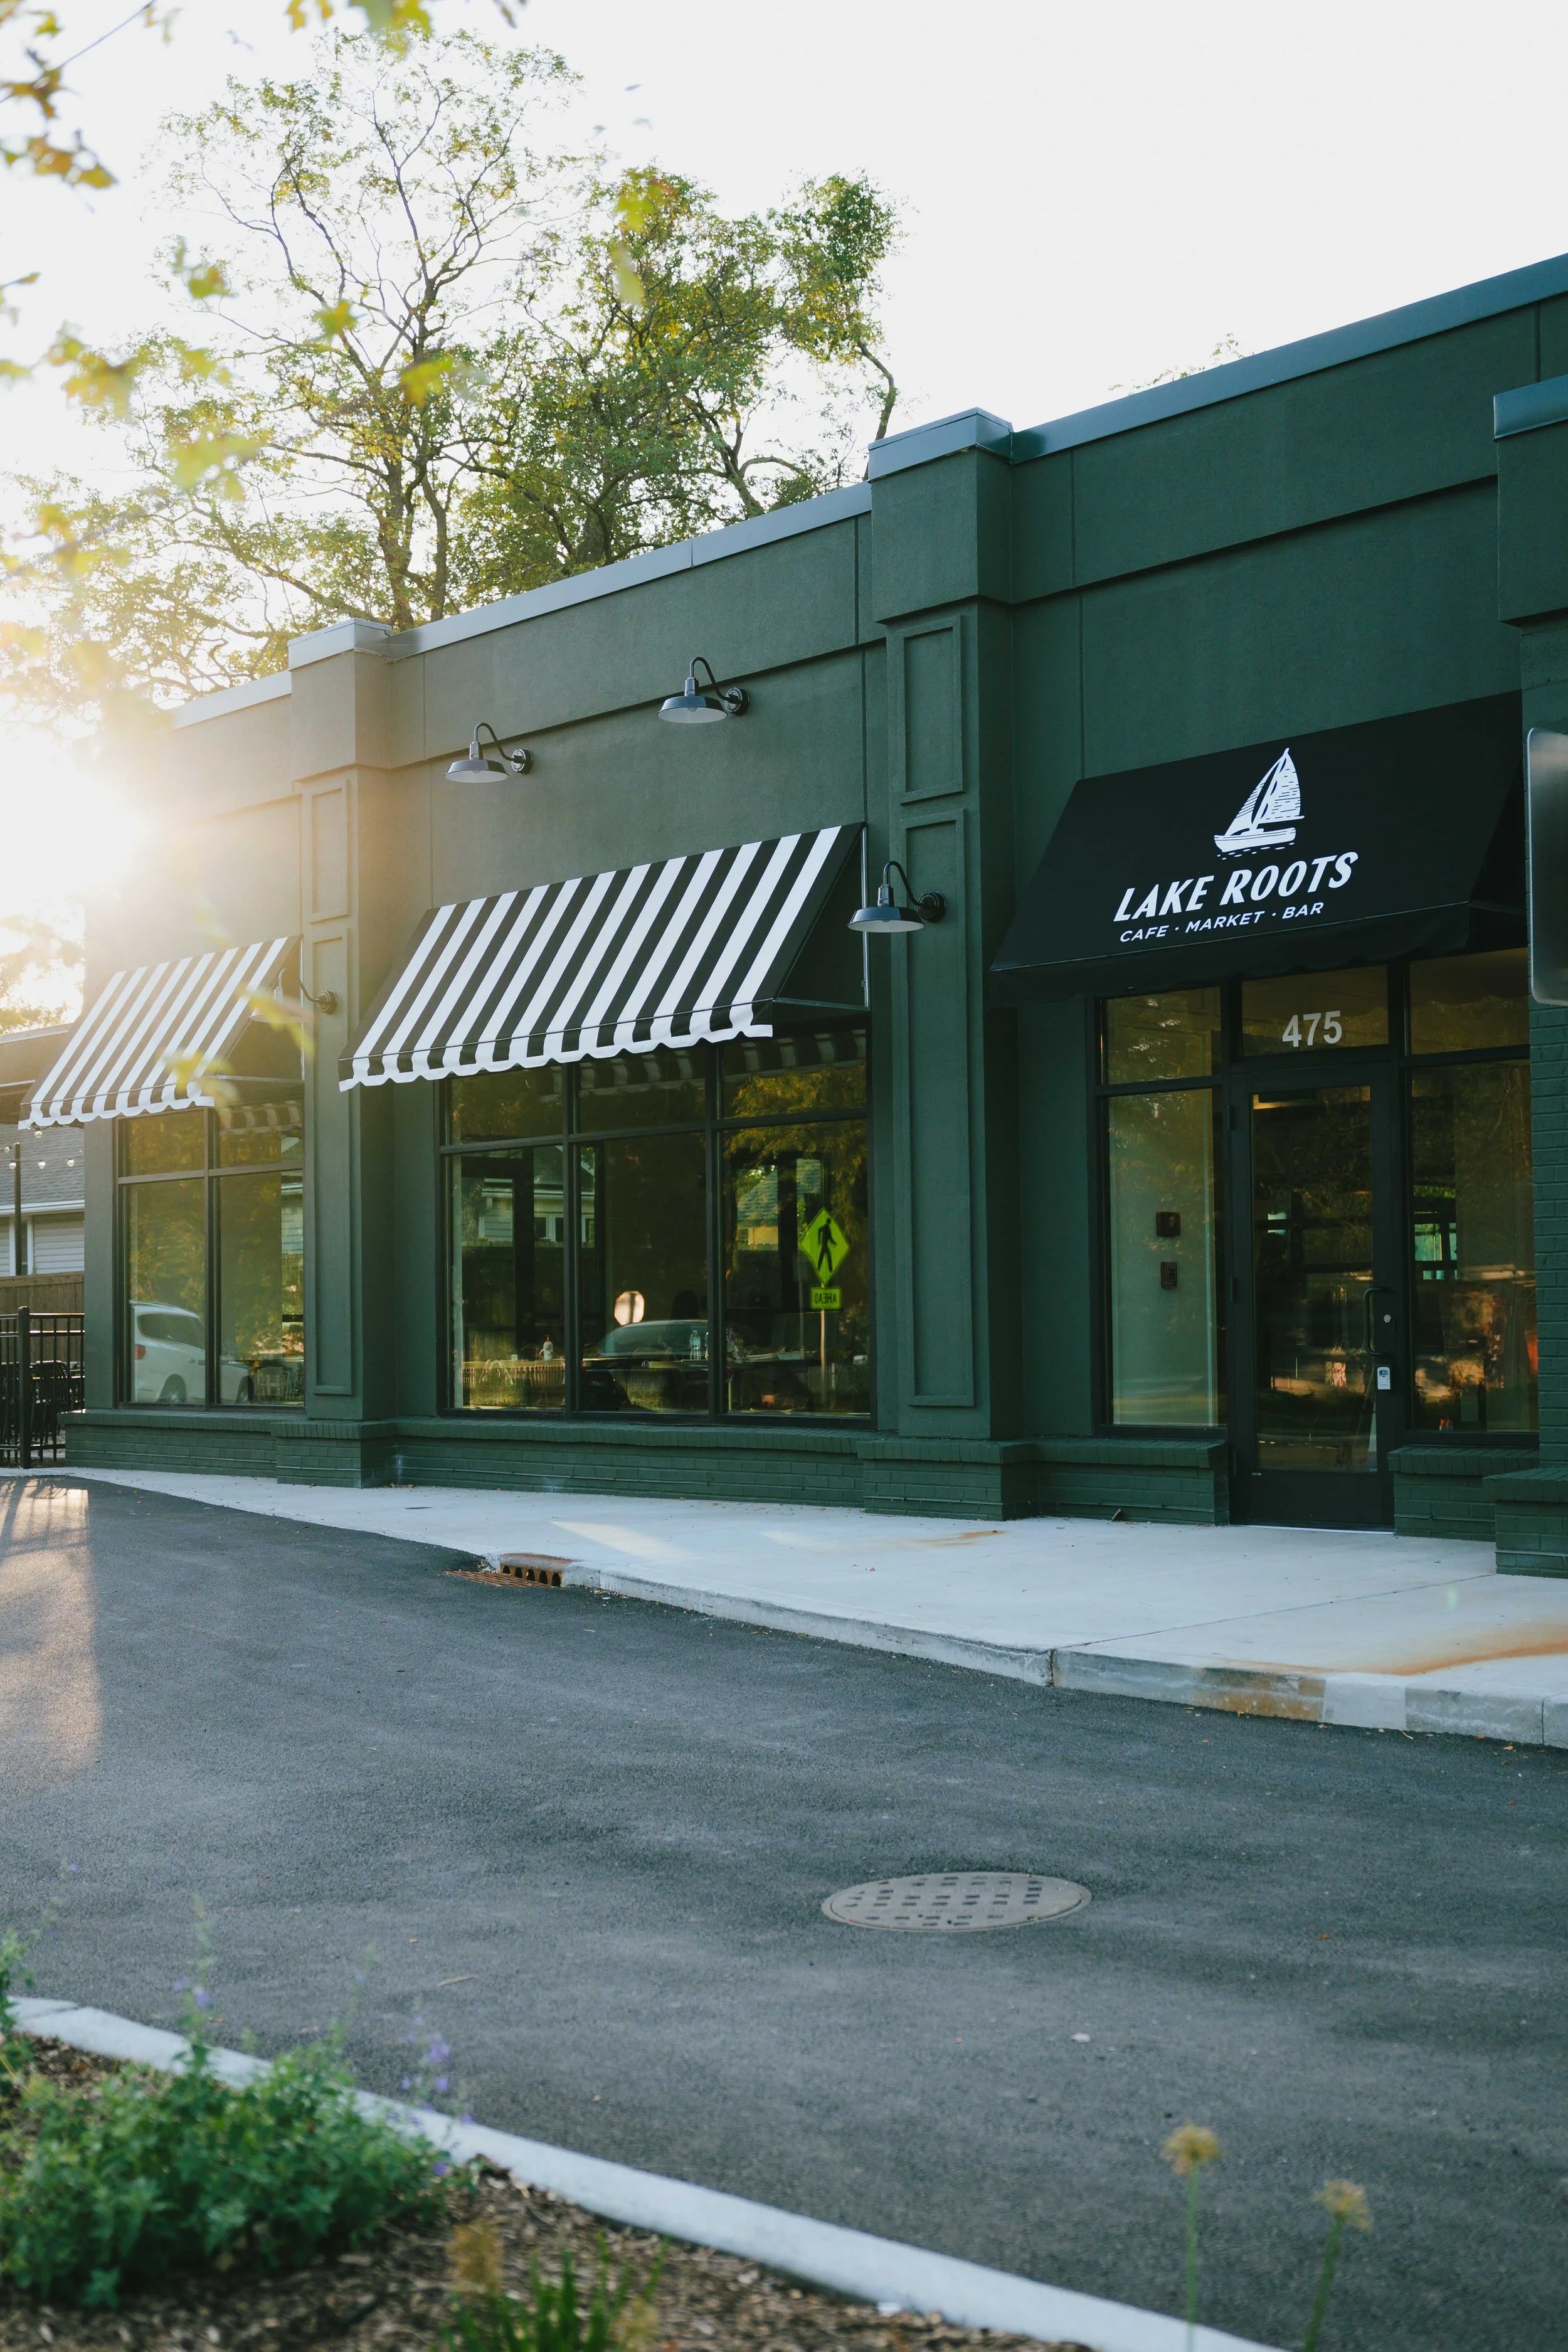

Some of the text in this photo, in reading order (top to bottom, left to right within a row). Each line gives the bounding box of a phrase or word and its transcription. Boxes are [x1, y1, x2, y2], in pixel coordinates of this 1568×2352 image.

[1113, 851, 1359, 922] LAKE ROOTS
[1120, 902, 1324, 942] CAFE MARKET BAR
[1282, 1010, 1342, 1047] 475
